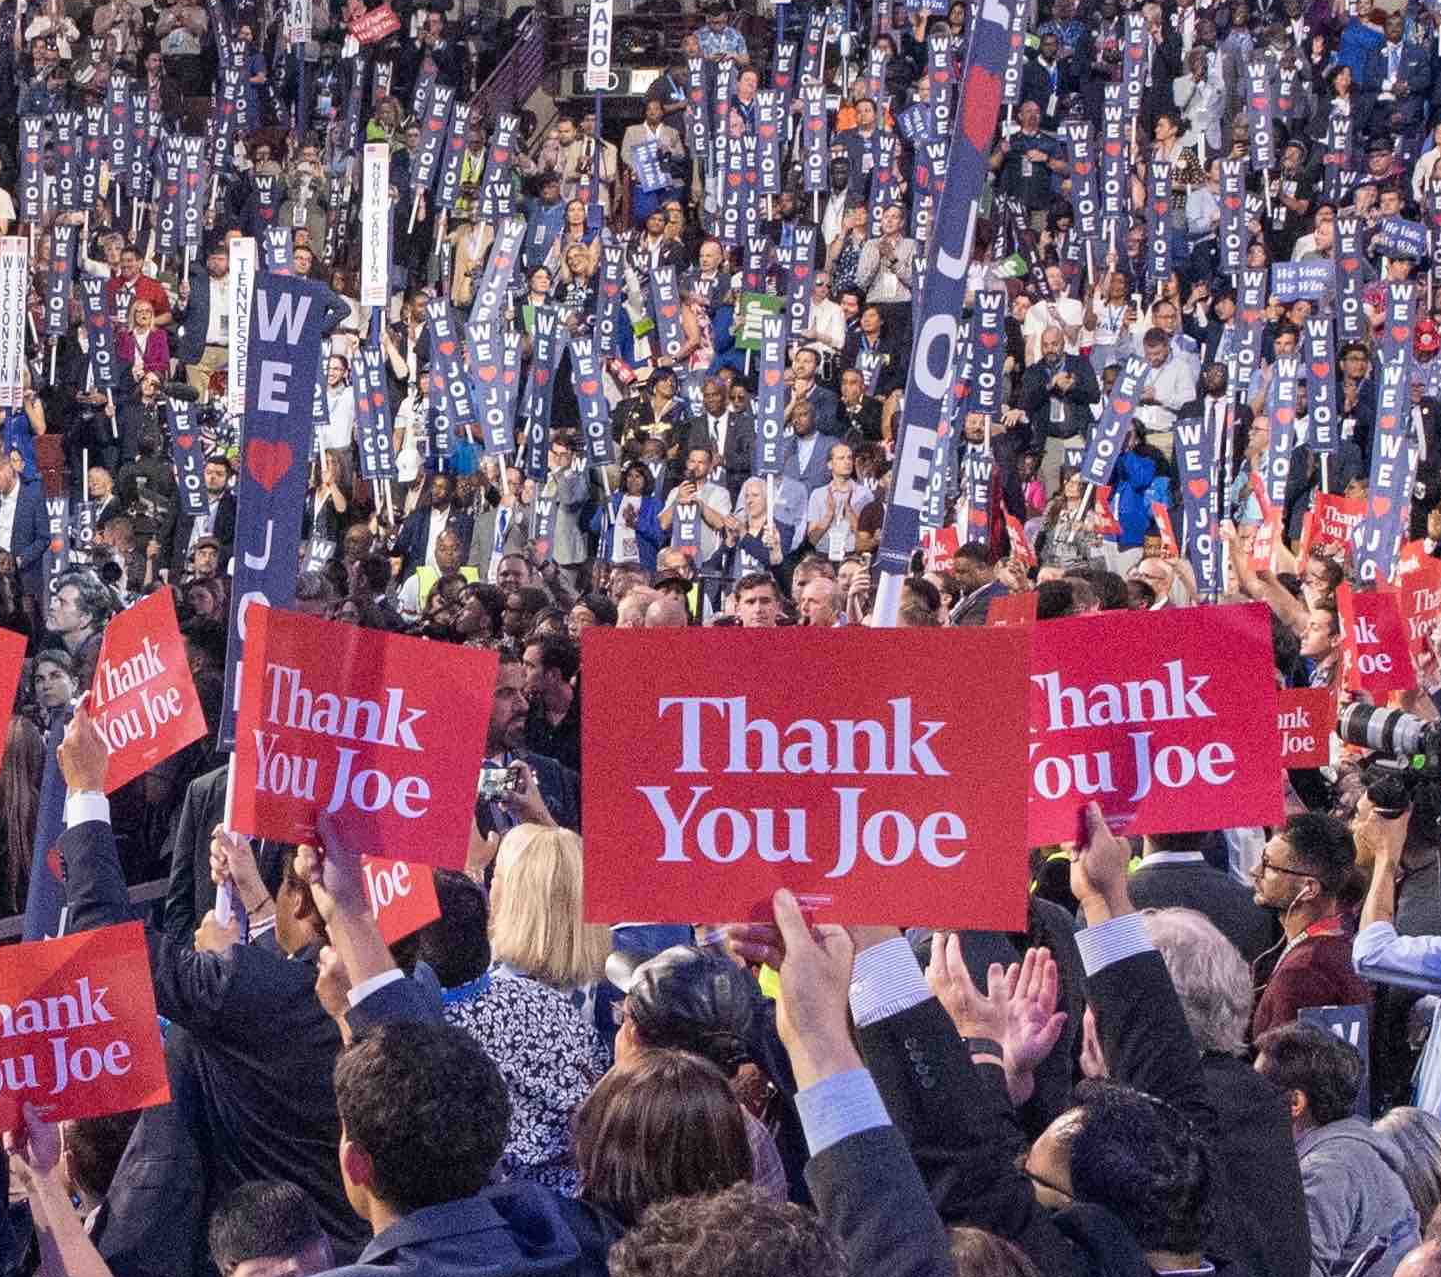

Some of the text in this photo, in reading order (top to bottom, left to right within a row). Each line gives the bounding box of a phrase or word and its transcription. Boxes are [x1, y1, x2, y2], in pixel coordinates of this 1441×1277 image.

[183, 137, 201, 237] WE JOE
[257, 289, 311, 417] WE
[470, 324, 507, 445] WE JOE
[764, 319, 781, 462] WE JOE
[900, 199, 978, 500] JOE
[142, 684, 183, 732] Joe
[265, 662, 426, 753] Thank
[657, 697, 952, 777] Thank
[1281, 733, 1316, 757] Joe
[253, 728, 431, 822] You Joe
[1127, 731, 1236, 802] Joe
[635, 786, 968, 879] You Joe
[364, 860, 413, 918] Joe
